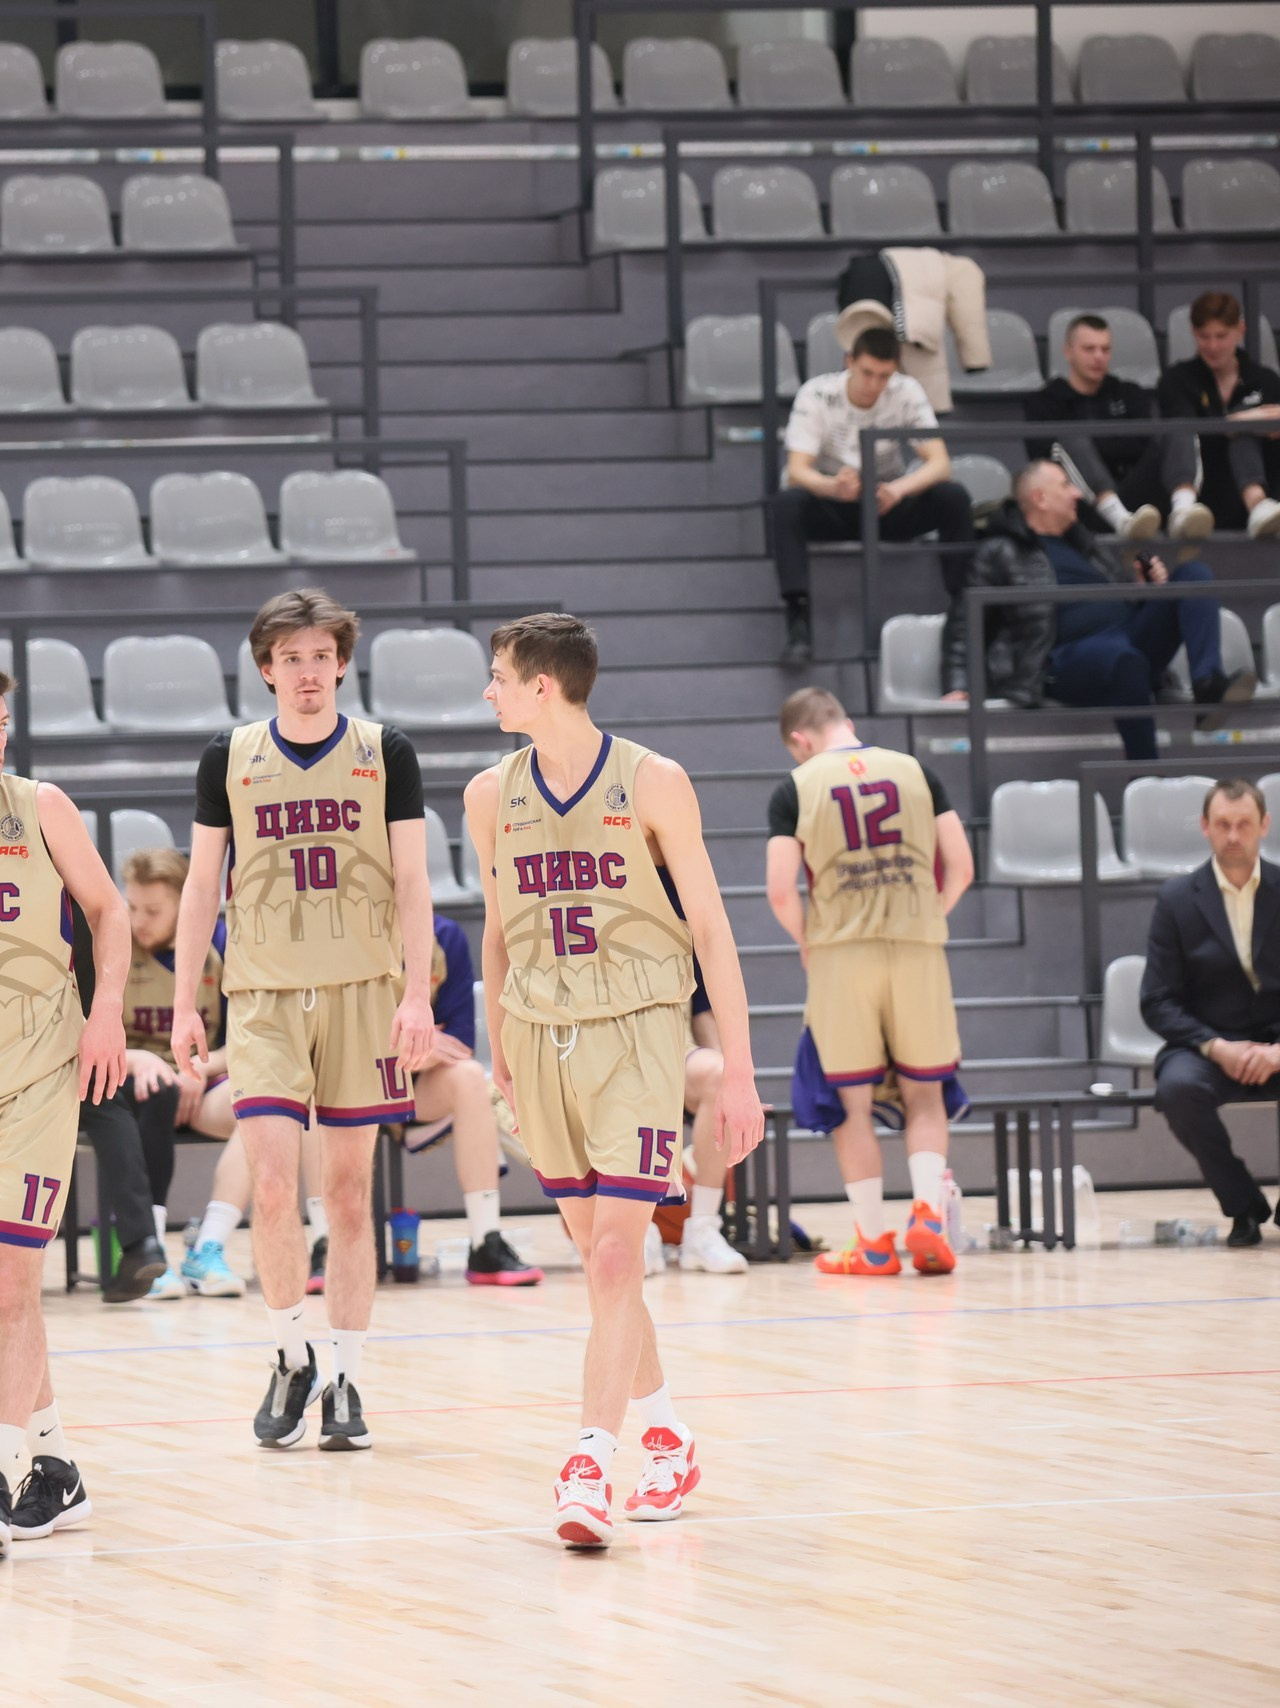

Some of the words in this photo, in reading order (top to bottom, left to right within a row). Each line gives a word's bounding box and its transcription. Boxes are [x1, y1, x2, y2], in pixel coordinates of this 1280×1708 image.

[255, 798, 361, 840] ЦИВС
[831, 780, 902, 851] 12
[290, 846, 337, 891] 10
[514, 850, 627, 897] ЦИВС
[549, 906, 598, 956] 15
[638, 1127, 677, 1177] 15
[22, 1173, 61, 1224] 17
